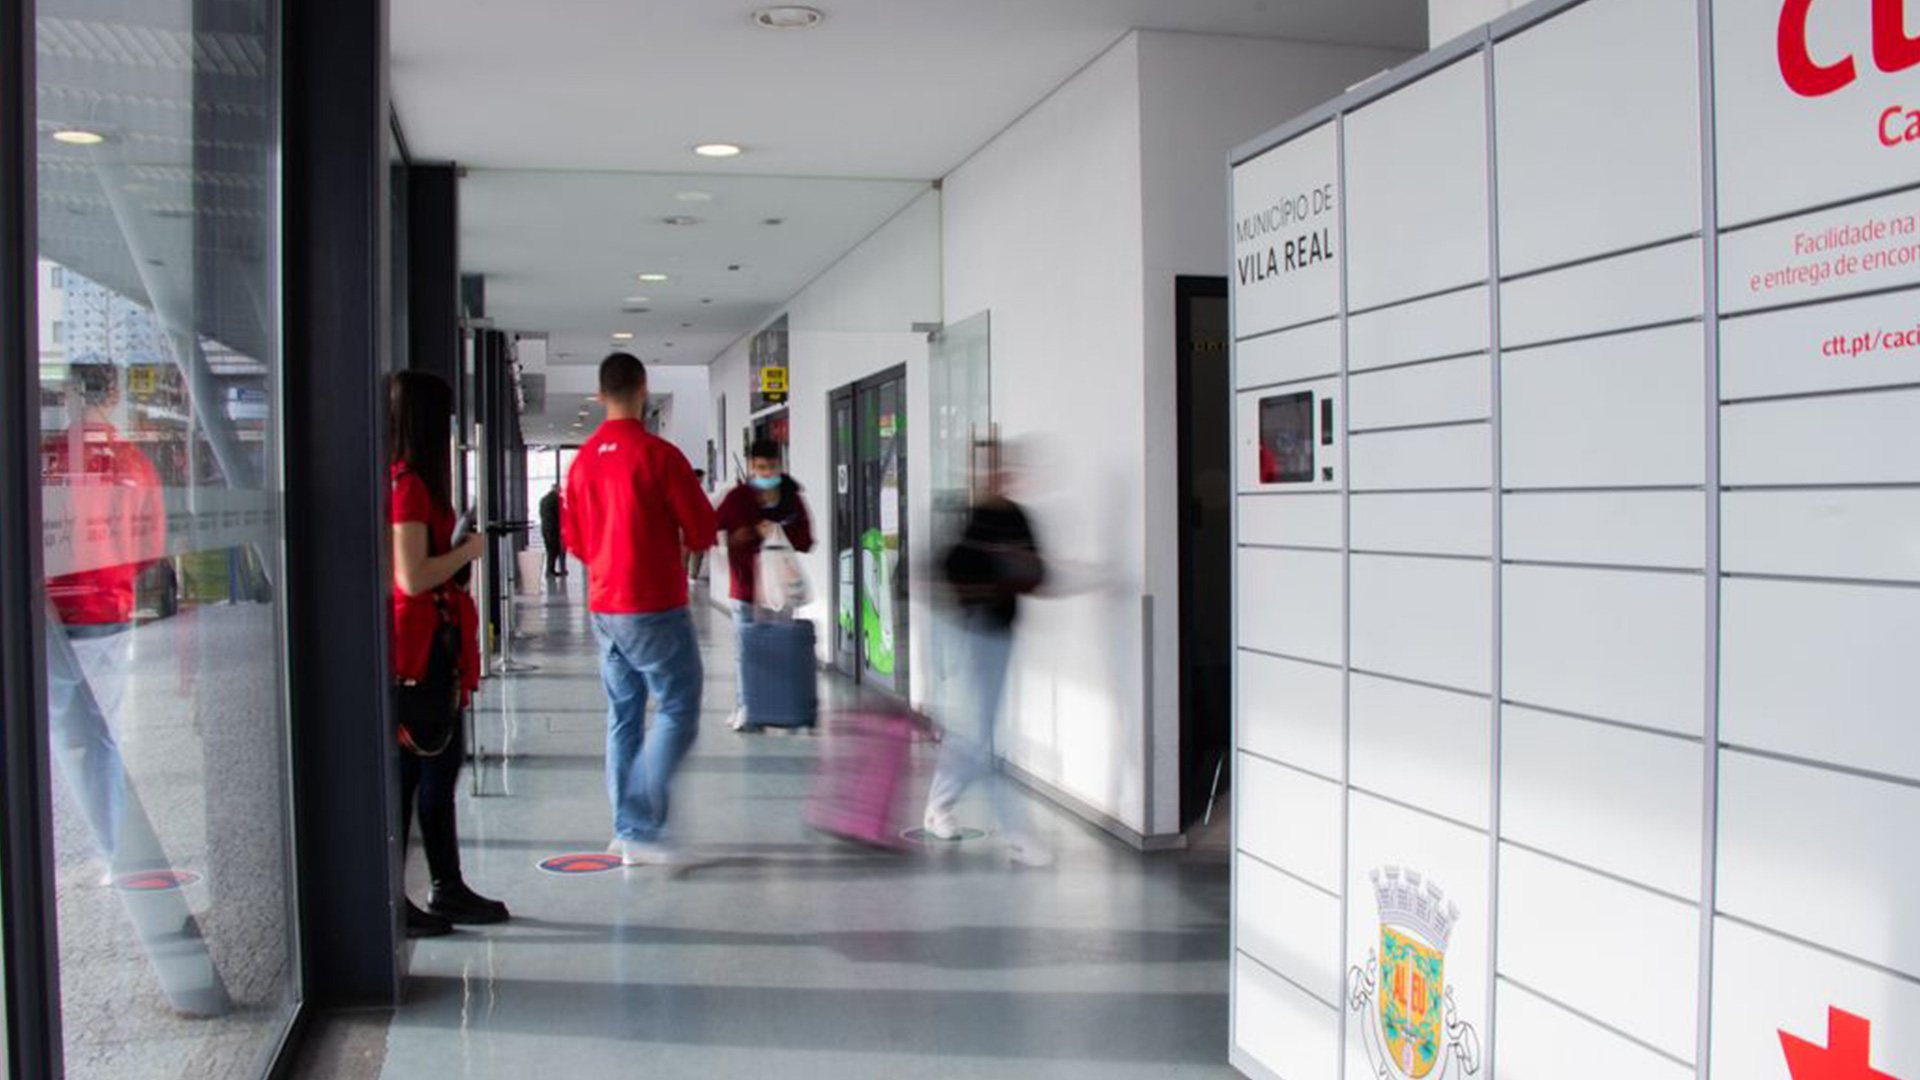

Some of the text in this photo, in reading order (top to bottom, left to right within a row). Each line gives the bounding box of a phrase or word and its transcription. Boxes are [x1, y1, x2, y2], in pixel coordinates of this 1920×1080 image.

[1236, 183, 1332, 242] MUNICÍPIO DE
[1794, 219, 1886, 255] Facilidade
[1890, 215, 1916, 235] na
[1238, 227, 1333, 286] VILA REAL
[1750, 274, 1761, 292] e
[1764, 261, 1831, 286] entrega
[1834, 254, 1858, 276] de
